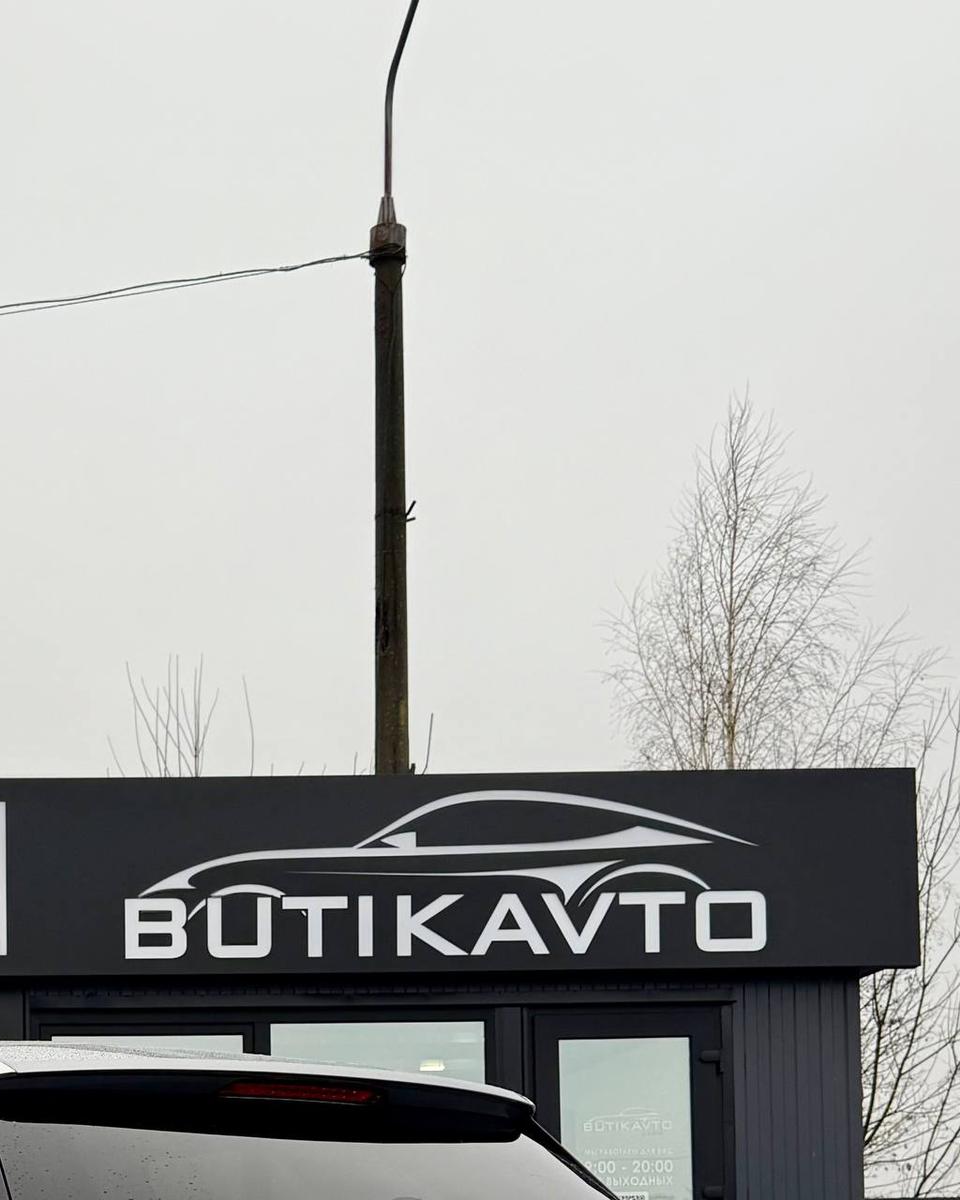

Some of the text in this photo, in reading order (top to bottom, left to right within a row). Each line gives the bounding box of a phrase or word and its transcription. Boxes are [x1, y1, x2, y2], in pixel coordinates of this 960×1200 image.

[123, 889, 768, 961] BUTIKAVTO
[583, 1120, 673, 1132] BUTIKAVTO
[632, 1159, 674, 1174] 20:00
